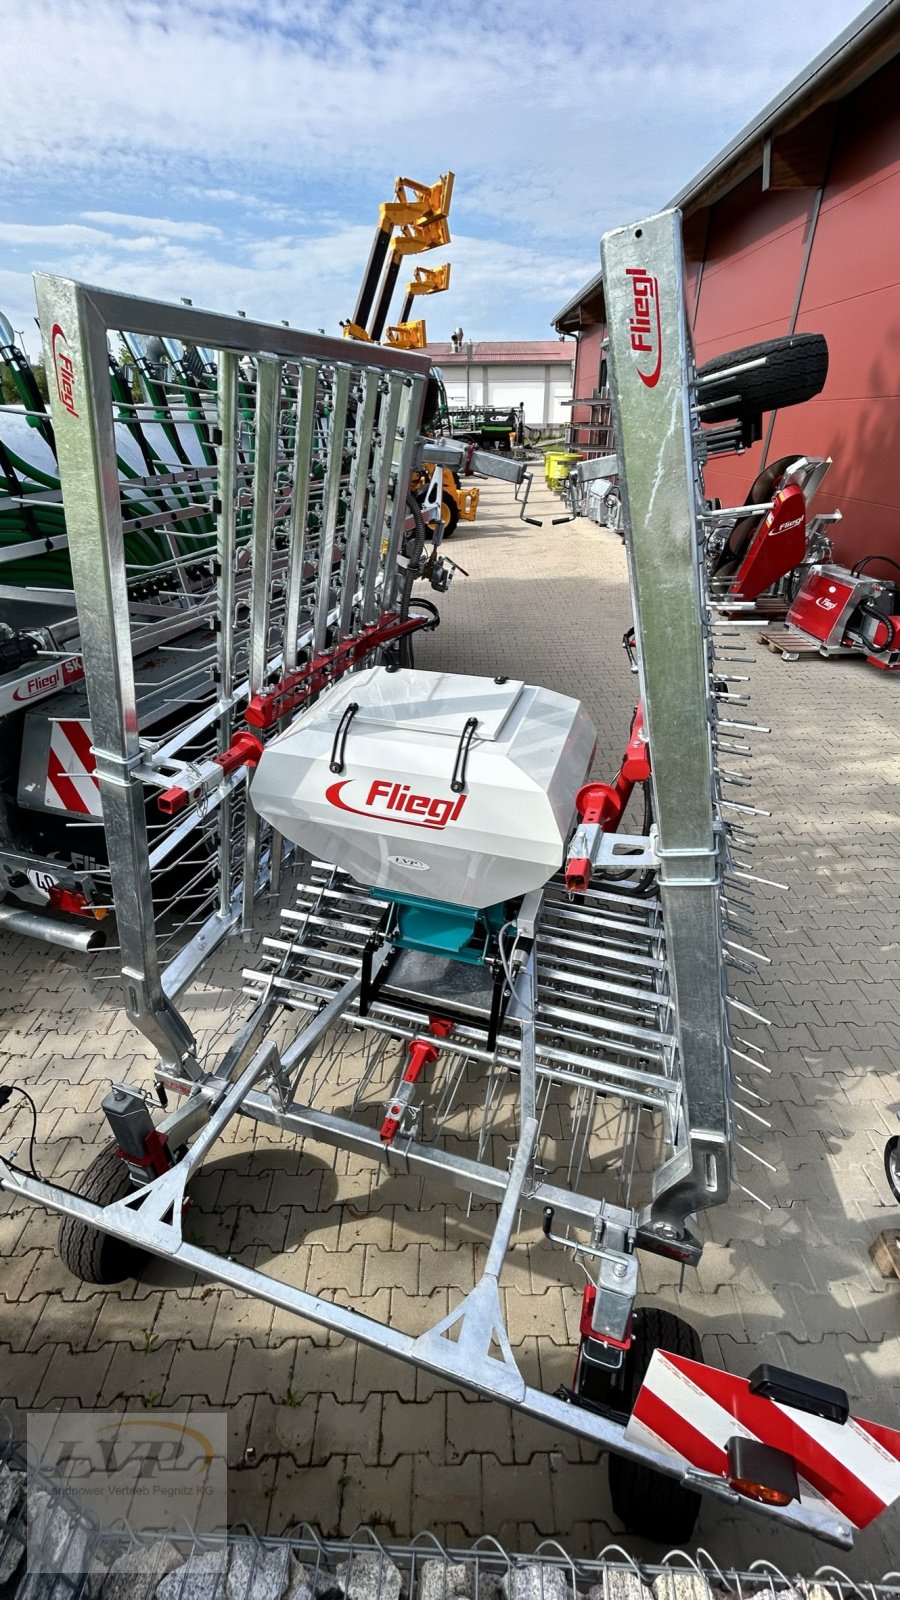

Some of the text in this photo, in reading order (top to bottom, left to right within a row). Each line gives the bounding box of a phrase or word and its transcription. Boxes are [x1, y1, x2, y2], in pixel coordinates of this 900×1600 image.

[625, 268, 654, 352] Fliegl
[59, 352, 79, 418] Fliegl
[27, 669, 60, 693] Fliegl
[366, 779, 468, 826] Fliegl
[35, 872, 55, 892] 40
[71, 851, 110, 877] Flie
